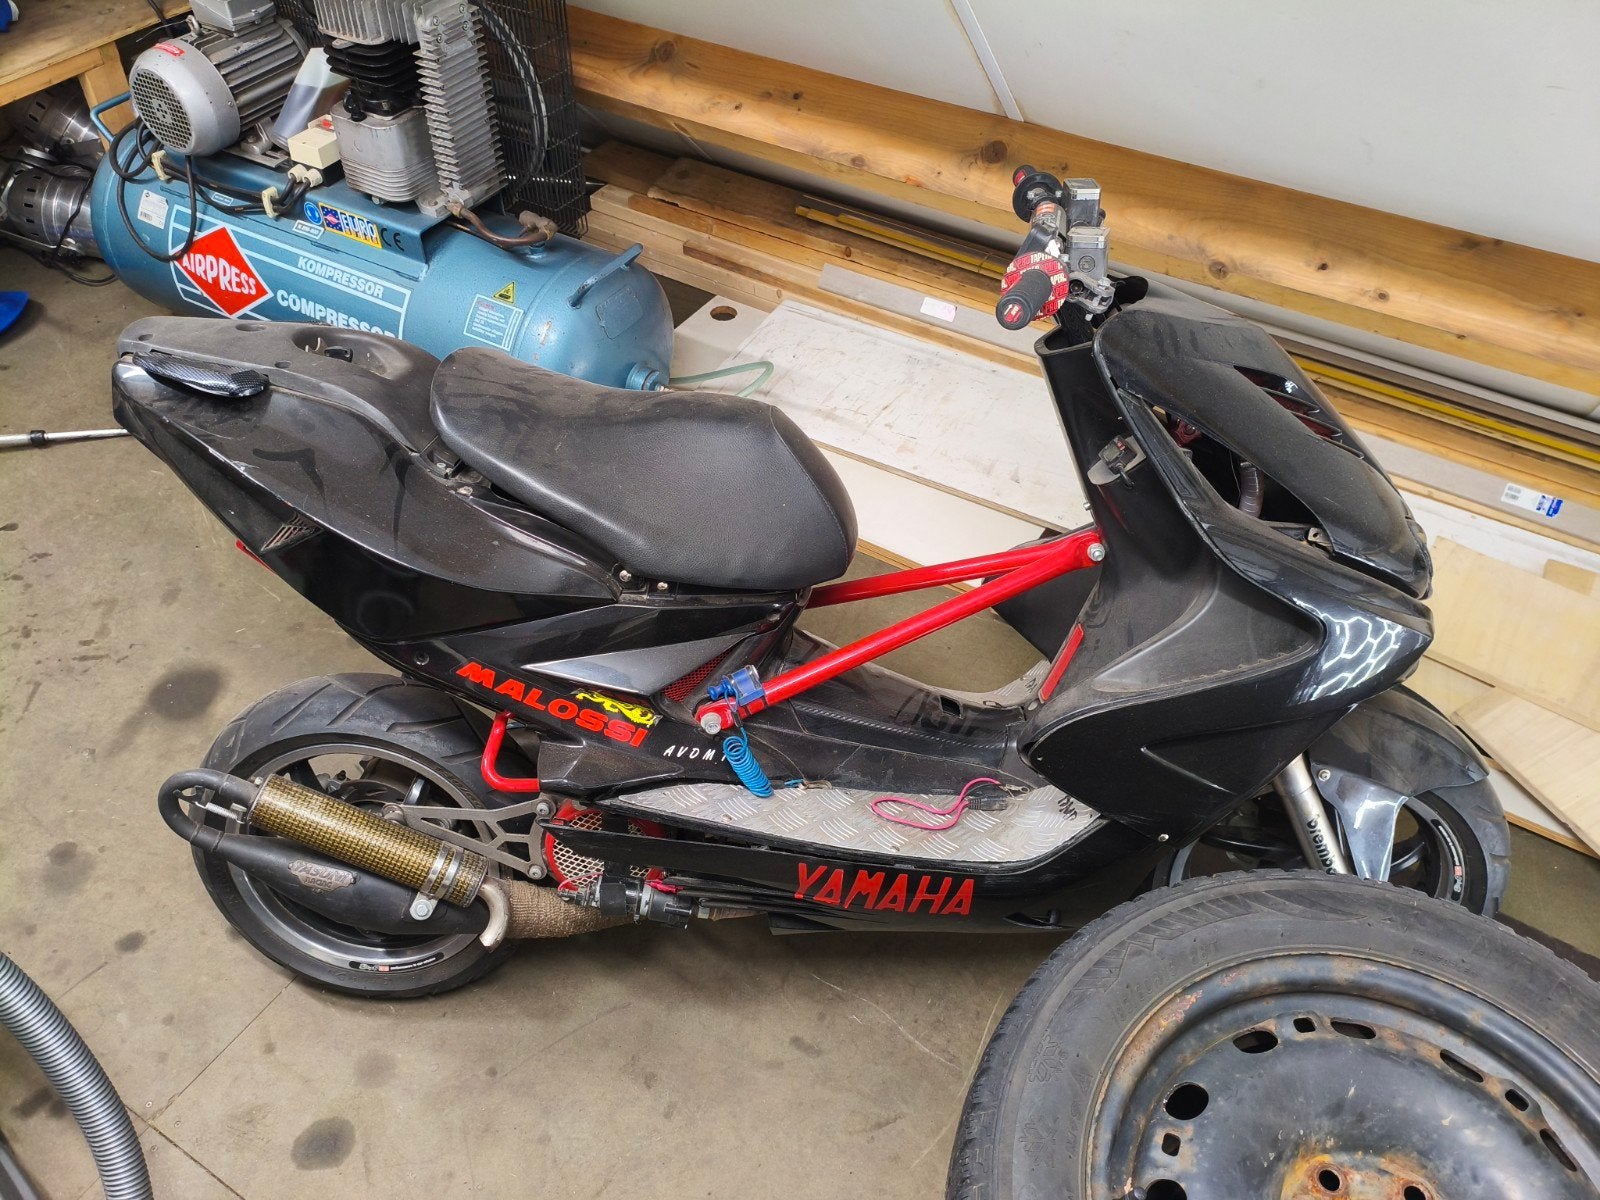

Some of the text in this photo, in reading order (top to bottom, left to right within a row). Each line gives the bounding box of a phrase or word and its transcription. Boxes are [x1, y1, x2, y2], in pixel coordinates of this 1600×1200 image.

[341, 211, 376, 237] EURO
[182, 253, 257, 296] AIRPRESS
[297, 256, 385, 299] KOMPRESSOR
[456, 661, 649, 748] MALOSSI
[794, 862, 975, 915] YAMAHA
